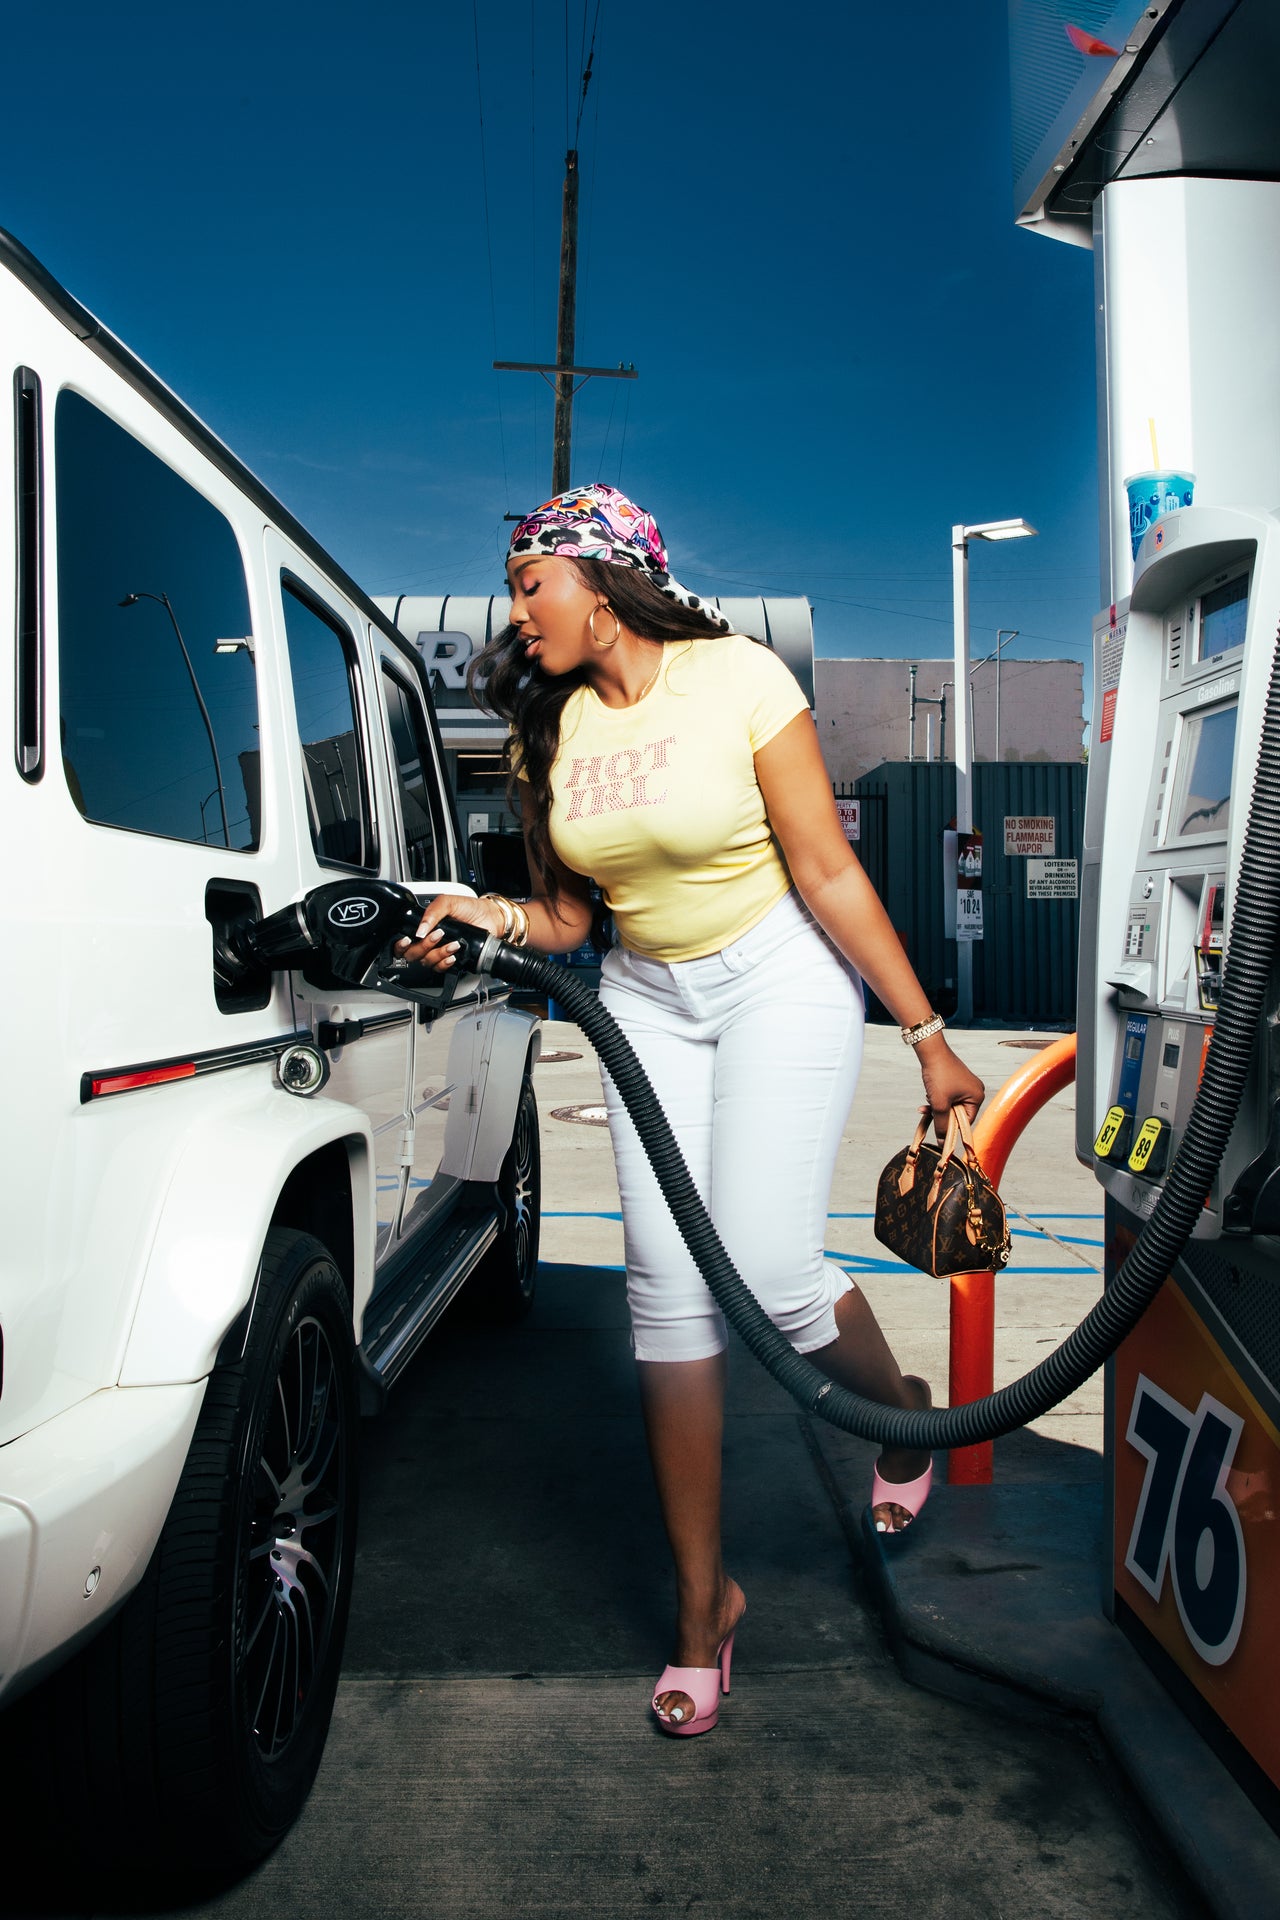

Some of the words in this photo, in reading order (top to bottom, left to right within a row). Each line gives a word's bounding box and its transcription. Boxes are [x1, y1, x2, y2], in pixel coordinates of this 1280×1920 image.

[1189, 607, 1194, 621] $
[1198, 680, 1236, 702] Gasoline
[564, 735, 677, 788] HOT
[1005, 819, 1016, 829] NO
[1018, 819, 1054, 830] SMOKING
[1006, 832, 1053, 842] FLAMMABLE
[1016, 843, 1042, 853] VAPOR
[337, 903, 368, 921] VST
[1127, 1021, 1147, 1034] REGULAR
[1167, 1027, 1180, 1041] PLUS
[1101, 1125, 1116, 1145] 87
[1135, 1137, 1152, 1159] 89
[1124, 1372, 1247, 1666] 76
